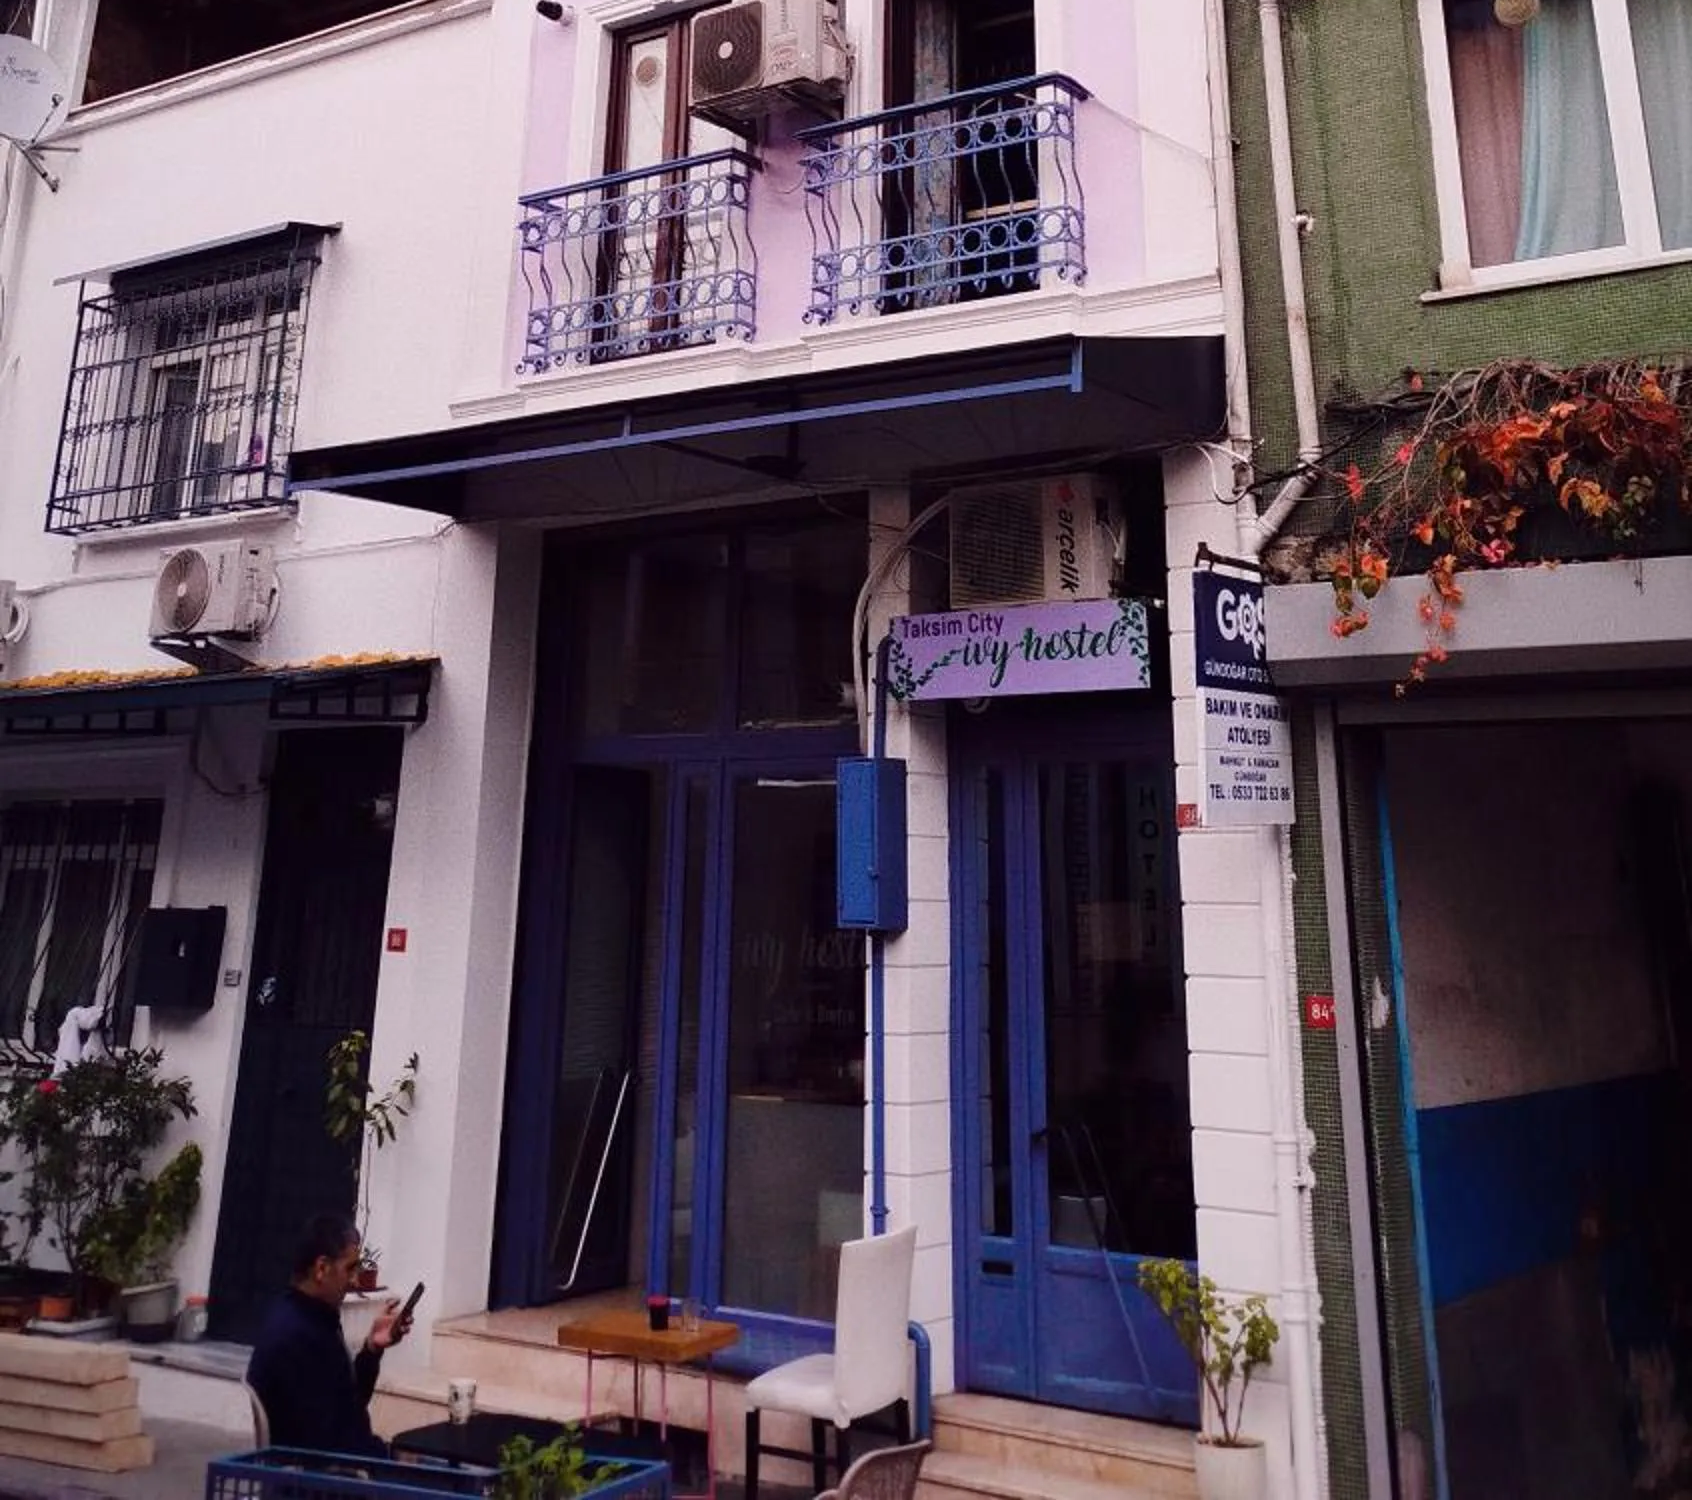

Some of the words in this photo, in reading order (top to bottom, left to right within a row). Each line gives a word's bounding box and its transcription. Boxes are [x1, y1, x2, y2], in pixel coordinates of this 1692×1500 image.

[902, 615, 963, 639] Taksim
[967, 612, 1004, 636] City
[961, 635, 1010, 689] ivy
[1022, 619, 1122, 662] hostel
[1205, 697, 1237, 716] BAKIM
[1240, 701, 1252, 719] VE
[1227, 725, 1271, 746] ATÖLYESİ
